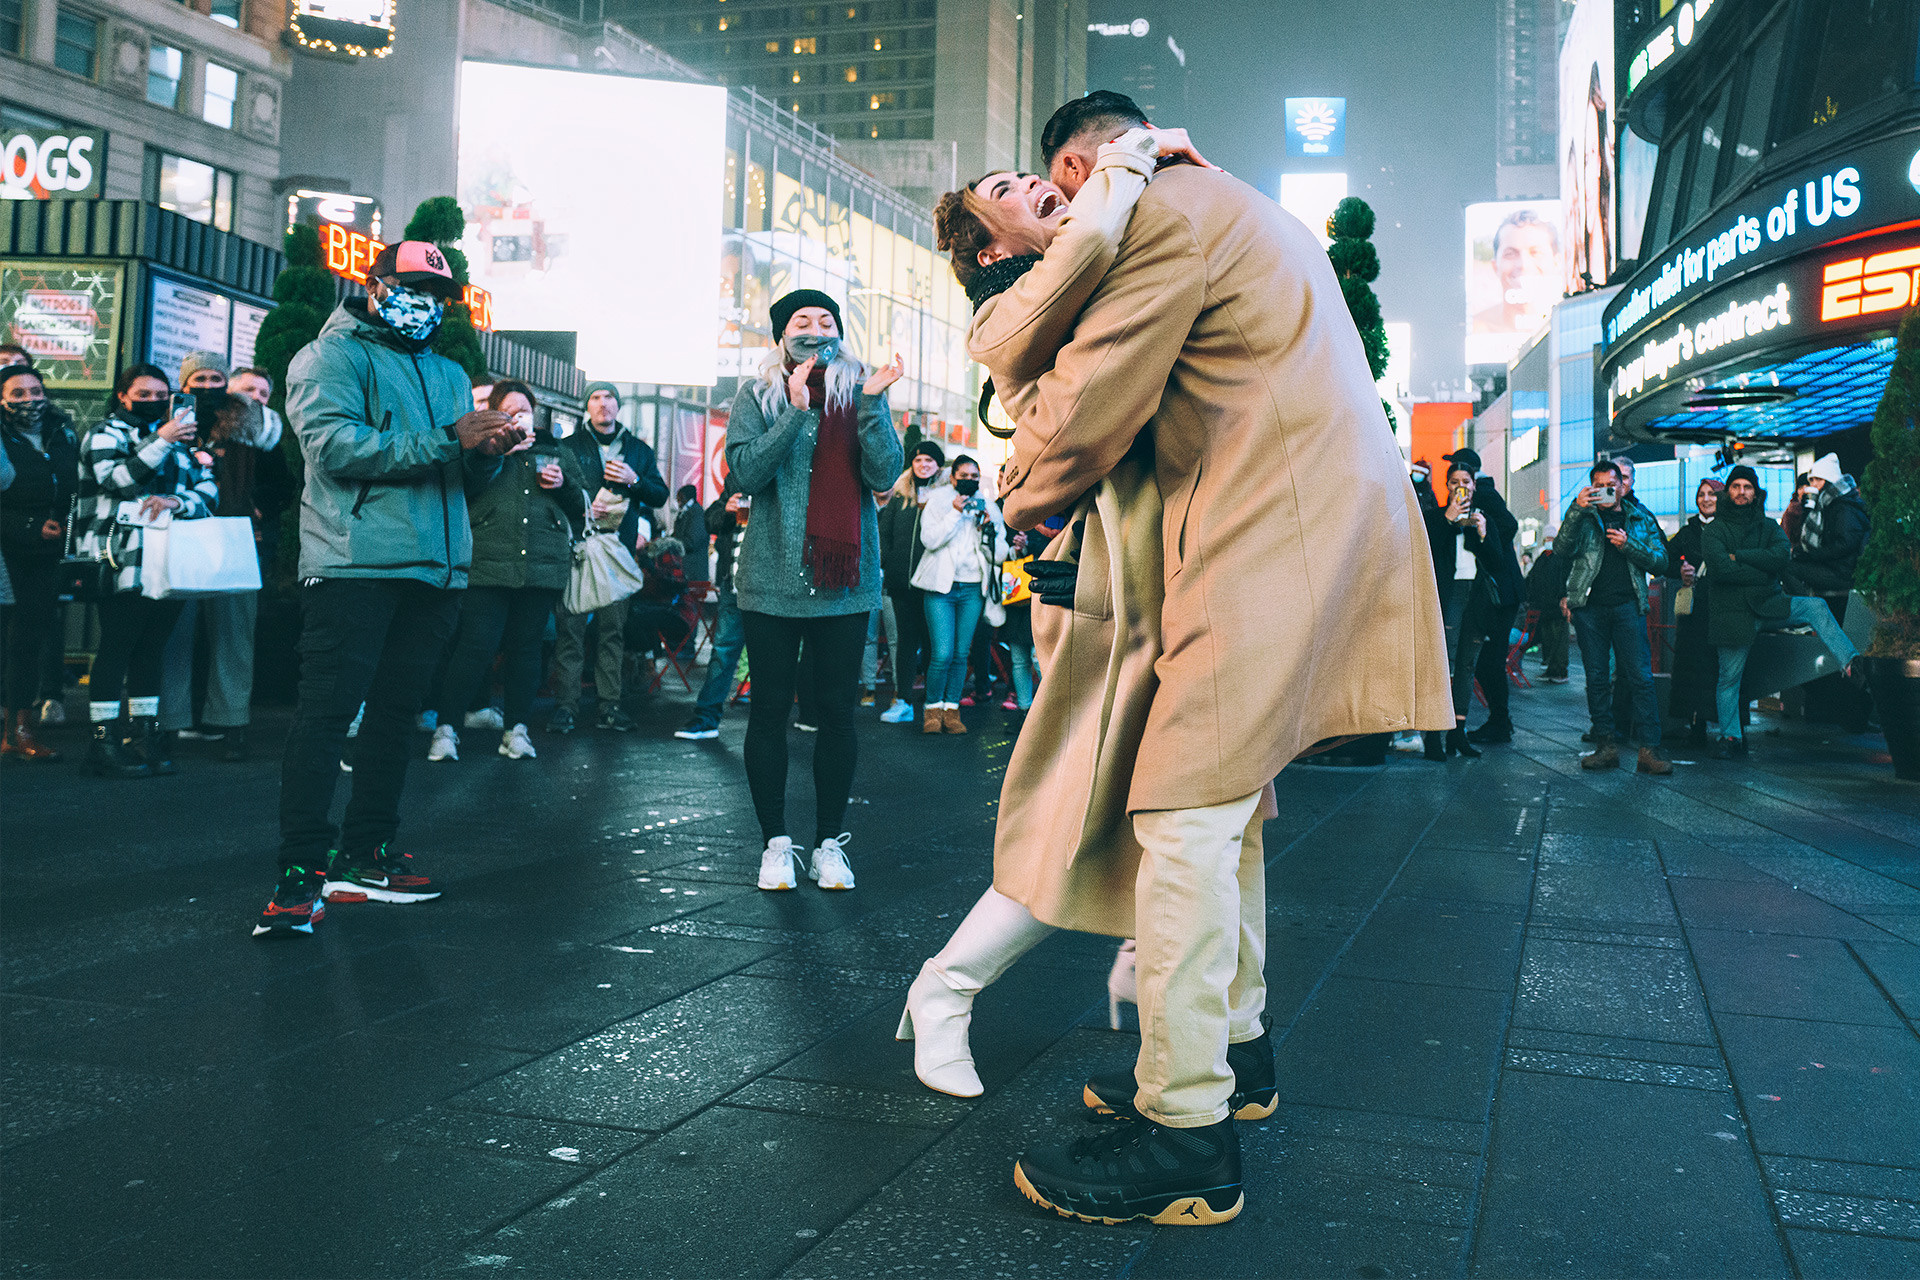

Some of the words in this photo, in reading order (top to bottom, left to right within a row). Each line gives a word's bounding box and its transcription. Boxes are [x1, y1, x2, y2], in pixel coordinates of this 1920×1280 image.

[0, 134, 94, 191] OGS
[1651, 253, 1682, 309] relief
[1683, 246, 1706, 287] for
[1707, 214, 1761, 282] parts
[1766, 188, 1798, 242] of
[1805, 167, 1861, 226] US
[25, 338, 78, 351] PANINIS
[1695, 282, 1791, 354] contract
